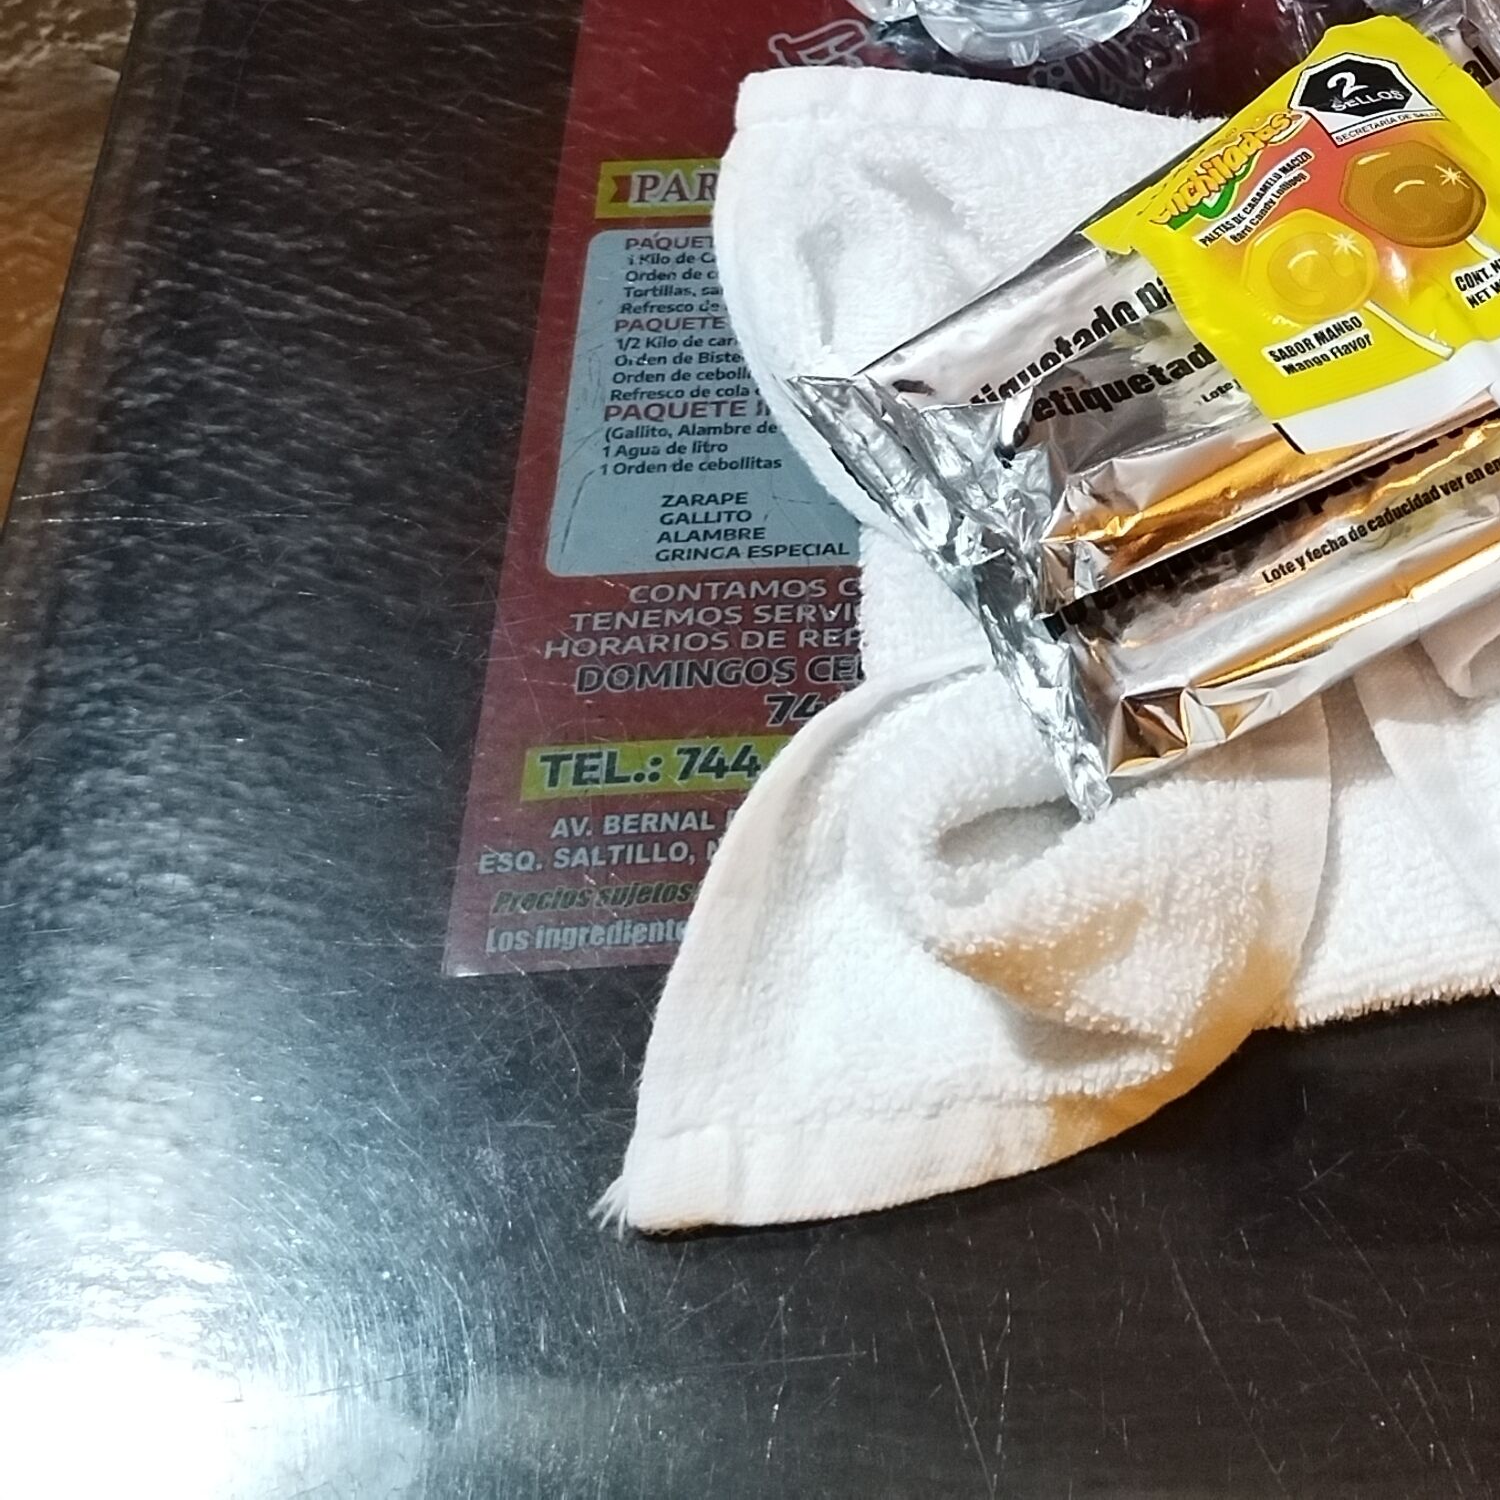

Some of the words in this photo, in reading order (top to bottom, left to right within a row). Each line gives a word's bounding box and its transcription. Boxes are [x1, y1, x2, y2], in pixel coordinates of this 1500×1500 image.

[1327, 71, 1370, 99] 2
[1330, 89, 1405, 112] SELLOS
[634, 172, 718, 204] PAR
[1199, 218, 1236, 248] PALETAS
[1242, 173, 1283, 215] CARAMELO
[625, 235, 714, 251] PAQUET
[675, 252, 695, 265] de
[625, 270, 677, 283] Orden
[682, 268, 702, 280] de
[1454, 267, 1494, 293] CONT.
[624, 285, 697, 298] Tortillas,
[1465, 288, 1492, 309] NET
[620, 301, 695, 315] Refresco
[614, 315, 727, 333] PAQUETE
[616, 337, 641, 352] 1/2
[645, 335, 678, 349] Kilo
[682, 335, 705, 348] de
[1268, 337, 1316, 363] SABOR
[1313, 315, 1363, 347] MANGO
[614, 353, 667, 367] Orden
[672, 352, 694, 365] de
[1282, 353, 1331, 376] Mango
[1329, 333, 1373, 360] Flavor
[612, 370, 665, 384] Orden
[671, 368, 692, 382] de
[1033, 340, 1219, 424] etiquetad
[610, 388, 686, 401] Refresco
[690, 385, 711, 398] de
[716, 384, 750, 398] cola
[604, 400, 748, 422] PAQUETE
[605, 426, 673, 443] (Gallito,
[678, 422, 752, 437] Alambre
[756, 421, 778, 435] de
[614, 444, 661, 460] Agua
[665, 441, 687, 455] de
[691, 439, 729, 454] litro
[612, 461, 668, 476] Orden
[671, 459, 694, 473] de
[699, 456, 783, 472] cebollitas
[661, 491, 750, 508] ZARAPE
[659, 509, 752, 526] GALLITO
[1260, 557, 1297, 585] Lote
[1304, 533, 1349, 564] fecha
[1348, 522, 1368, 543] de
[1366, 485, 1441, 533] caducidad
[1439, 477, 1464, 496] ver
[1464, 467, 1486, 485] en
[656, 526, 766, 544] ALAMBRE
[655, 546, 745, 563] GRINGA
[747, 542, 850, 560] ESPECIAL
[628, 578, 828, 605] CONTAMOS
[570, 604, 743, 633] TENEMOS
[753, 602, 861, 624] SERVI
[544, 631, 730, 660] HORARIOS
[739, 630, 787, 650] DE
[575, 655, 796, 696] DOMINGOS
[538, 749, 664, 790] TEL.:
[674, 743, 763, 782] 744
[550, 816, 593, 840] AV.
[602, 808, 716, 837] BERNAL
[477, 850, 543, 876] ESQ.
[552, 840, 696, 870] SALTILLO,
[490, 884, 596, 916] Precios
[594, 880, 693, 909] sujetos
[484, 926, 531, 955] Los
[534, 918, 688, 954] ingrediente
